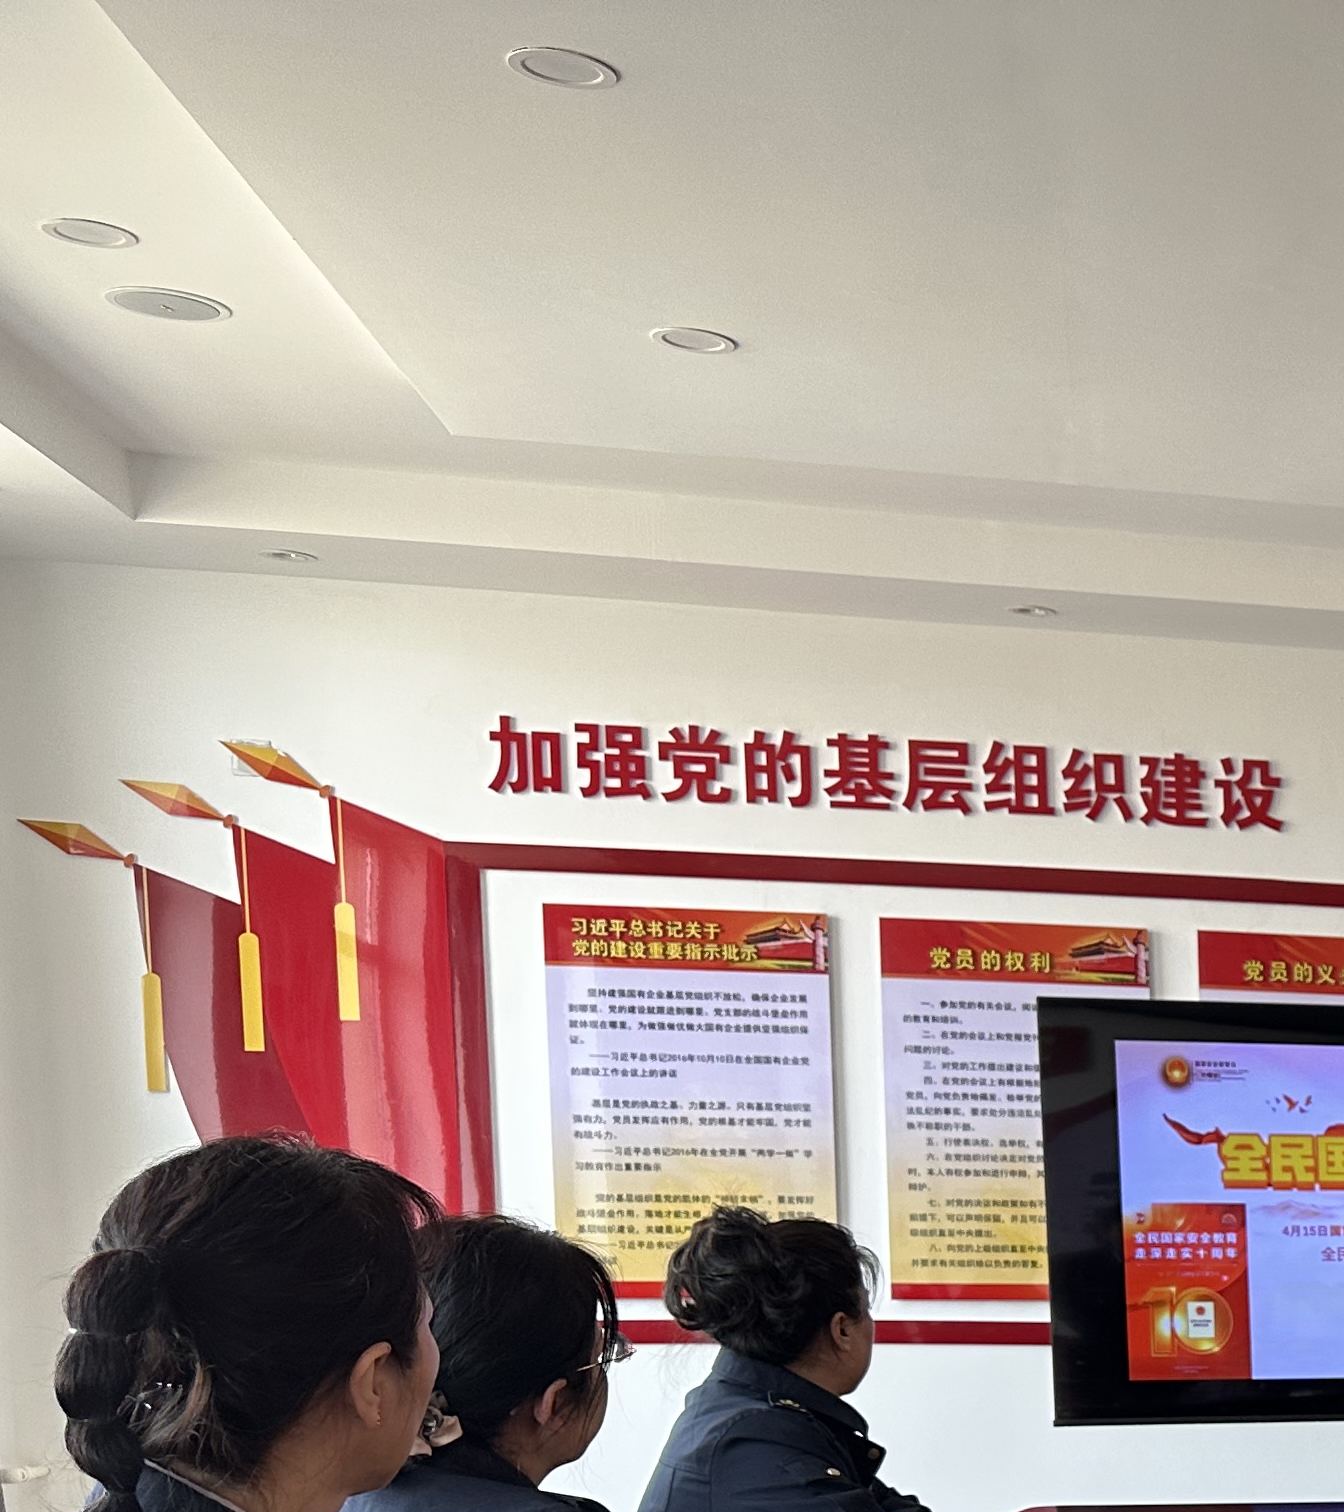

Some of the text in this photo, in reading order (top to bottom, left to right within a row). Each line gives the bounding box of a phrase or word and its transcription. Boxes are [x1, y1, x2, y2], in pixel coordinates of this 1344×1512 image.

[489, 715, 1286, 832] 加强党的基层组织建设
[570, 917, 721, 940] 习近平总书记关于
[572, 941, 759, 962] 党的建设重要指示批示
[929, 946, 1052, 974] 党员的权利
